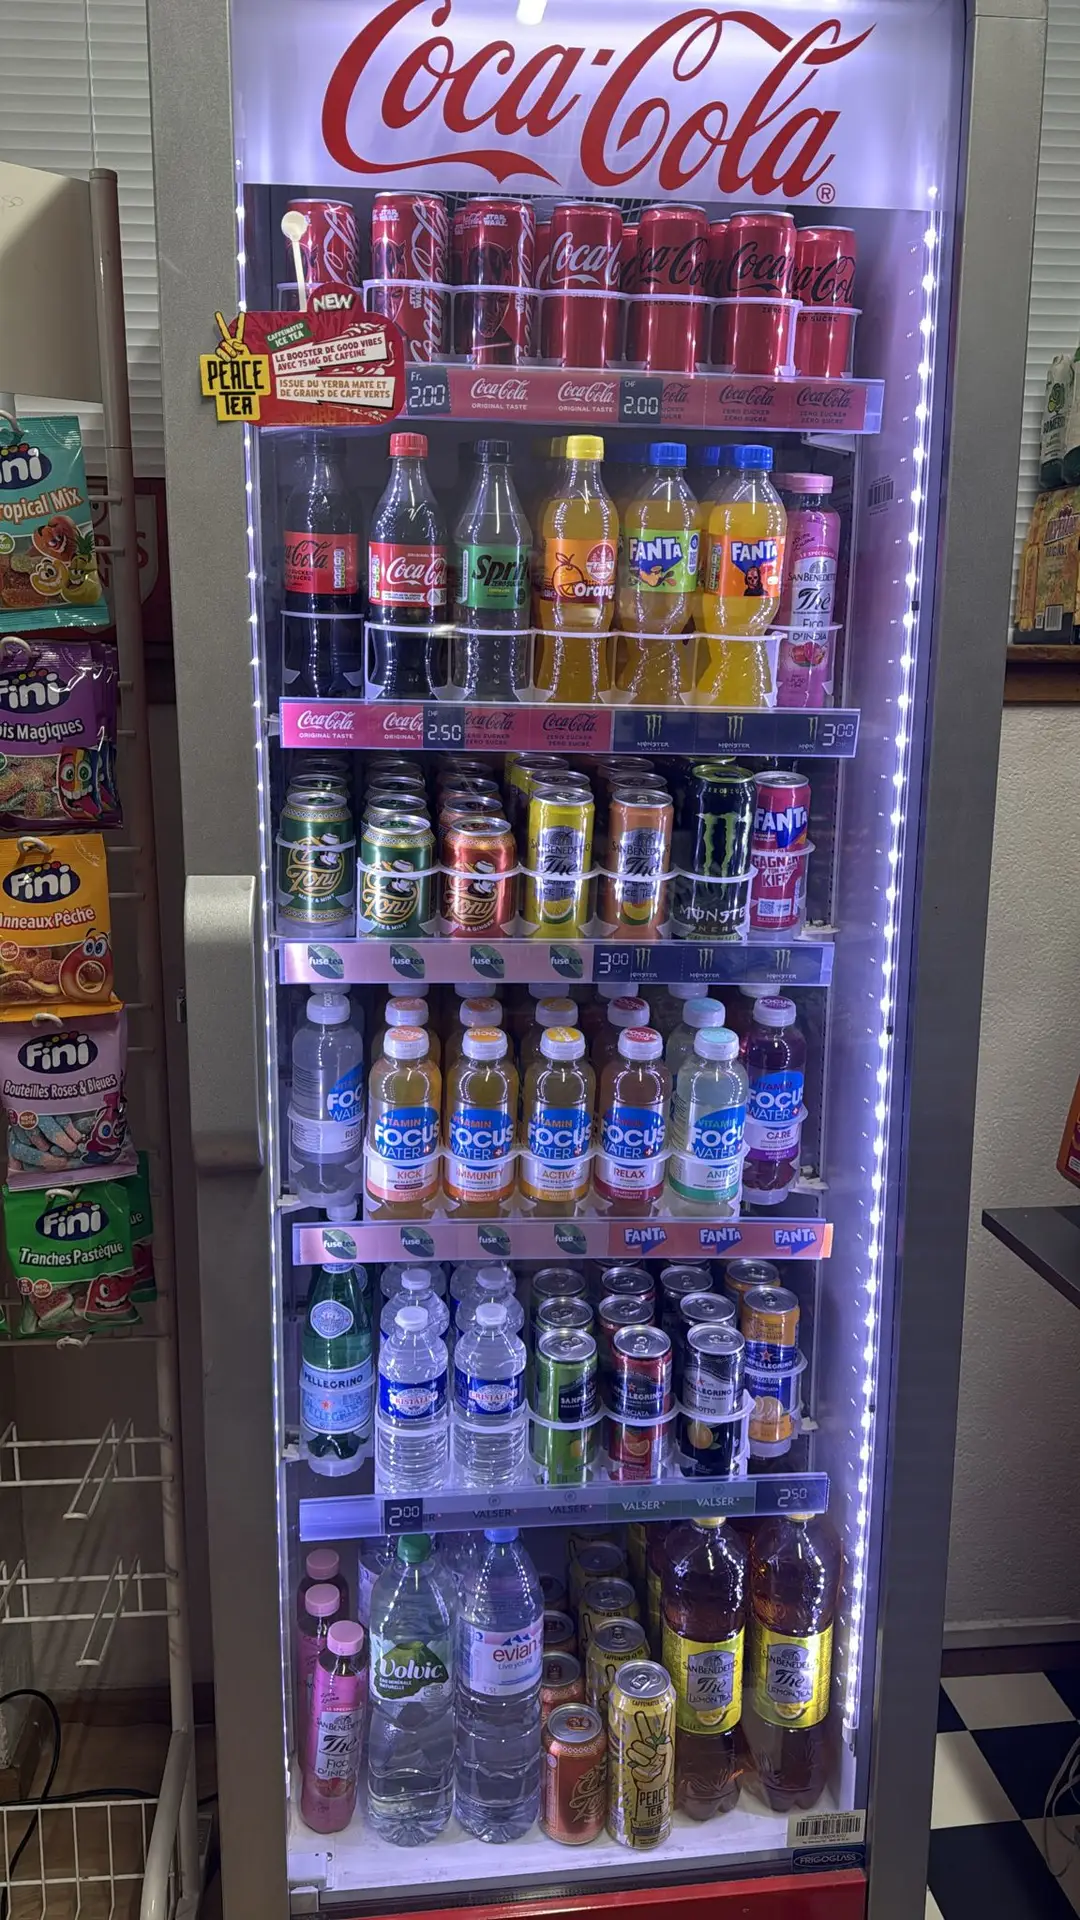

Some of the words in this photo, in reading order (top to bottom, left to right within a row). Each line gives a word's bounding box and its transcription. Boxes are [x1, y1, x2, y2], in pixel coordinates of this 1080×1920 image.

[321, 0, 876, 198] Coca-Cola
[313, 293, 353, 313] NEW
[267, 322, 304, 342] CAFFEINATED
[275, 335, 289, 348] ICE
[289, 331, 304, 343] TEA
[275, 354, 285, 363] LE
[287, 347, 323, 361] BOOSTER
[325, 345, 335, 354] DE
[337, 341, 359, 352] GOOD
[360, 337, 383, 347] VIBES
[277, 361, 298, 371] AVEC
[299, 359, 308, 368] 75
[309, 357, 321, 367] MG
[322, 355, 333, 365] DE
[207, 360, 264, 390] PEACE
[279, 379, 305, 388] ISSUE
[307, 380, 319, 388] DU
[322, 381, 350, 389] YERBA
[377, 381, 387, 389] ET
[411, 371, 423, 381] Fr.
[280, 389, 292, 397] DE
[293, 389, 325, 398] GRAINS
[327, 390, 338, 398] DE
[363, 390, 390, 399] VERTS
[409, 384, 446, 407] 2.00
[470, 378, 531, 400] Coca-Cola
[557, 380, 616, 403] Coca-Cola
[719, 384, 776, 406] Coca-Cola
[797, 386, 852, 409] Coca-Cola
[219, 391, 256, 415] TEA
[623, 395, 659, 416] 2.00
[0, 496, 49, 525] ropical
[51, 487, 82, 512] Mix
[629, 536, 682, 560] FANTA
[731, 540, 778, 561] FANTA
[472, 555, 529, 586] Sprit
[575, 583, 615, 599] Orang
[17, 718, 84, 743] Magiques
[297, 711, 356, 730] Coca-Cola
[542, 714, 598, 733] Coca-Cola
[427, 724, 462, 742] 2.50
[754, 806, 808, 833] FANTA
[10, 865, 72, 900] Fini
[54, 905, 95, 928] Pêche
[309, 957, 343, 965] fusetea
[391, 956, 424, 965] fusetea
[471, 956, 504, 965] fusetea
[551, 957, 583, 966] fusetea
[26, 1034, 89, 1070] Fini
[4, 1080, 49, 1098] Bouteilles
[52, 1083, 77, 1098] Roses
[79, 1083, 86, 1094] &
[87, 1074, 116, 1092] Bleues
[374, 1121, 440, 1147] FOCUS
[450, 1123, 514, 1148] FOCUS
[527, 1121, 592, 1147] FOCUS
[600, 1119, 666, 1147] FOCUS
[692, 1122, 745, 1147] FOCU
[766, 1130, 791, 1140] CARE
[376, 1142, 421, 1160] WATER
[397, 1170, 423, 1179] KICK
[455, 1168, 505, 1181] IMMUNITY
[613, 1168, 645, 1179] RELAX
[44, 1204, 101, 1237] Fini
[624, 1227, 667, 1242] FANTA
[700, 1227, 742, 1243] FANTA
[774, 1228, 817, 1244] FANTA
[20, 1248, 71, 1265] Tranches
[74, 1242, 124, 1261] Pastèque
[548, 1504, 587, 1514] VALSER
[621, 1501, 660, 1511] VALSER
[696, 1497, 735, 1508] VALSER
[472, 1509, 512, 1519] VALSER
[493, 1640, 537, 1663] evian
[380, 1658, 443, 1680] Volvic
[498, 1661, 514, 1670] Live
[515, 1657, 533, 1669] young
[689, 1694, 718, 1703] LEMON
[639, 1785, 667, 1806] PEACE
[644, 1801, 664, 1817] TEA
[800, 1854, 856, 1865] FRIGOGLASS
